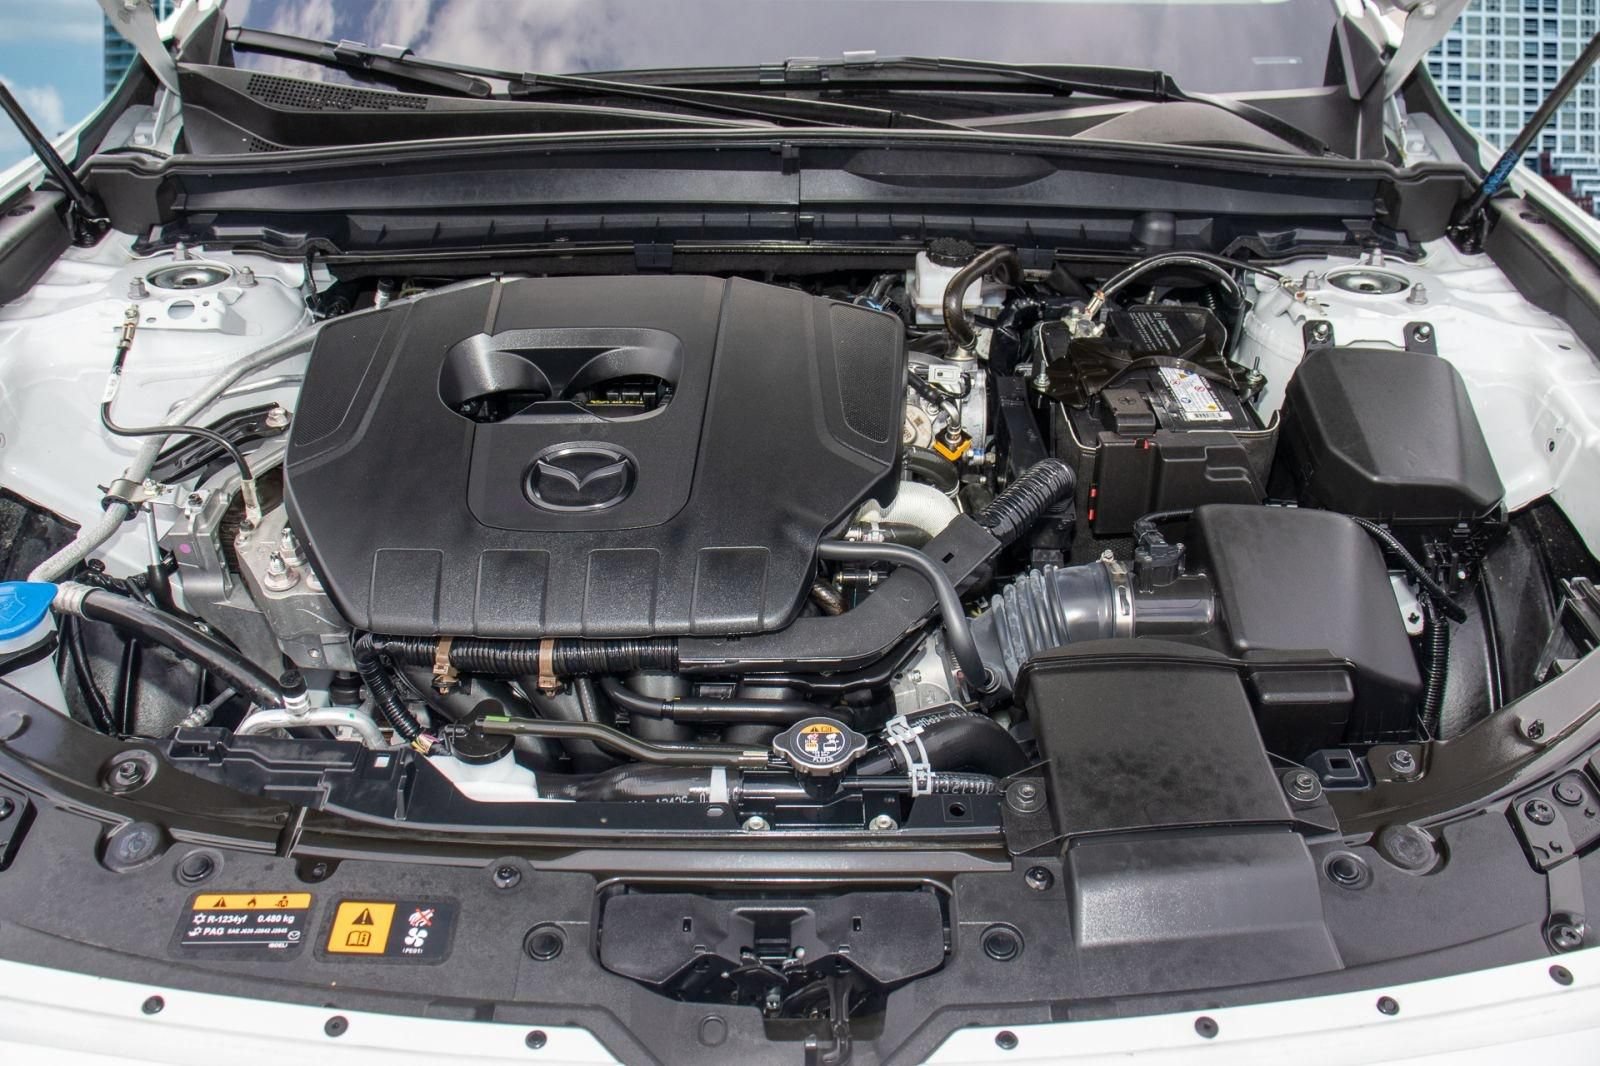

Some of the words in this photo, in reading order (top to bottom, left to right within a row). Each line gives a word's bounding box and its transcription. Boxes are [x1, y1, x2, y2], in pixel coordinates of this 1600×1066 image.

[207, 914, 248, 924] R-1234yf
[257, 914, 282, 923] 0.480
[283, 914, 295, 924] kg
[203, 927, 225, 936] PAG
